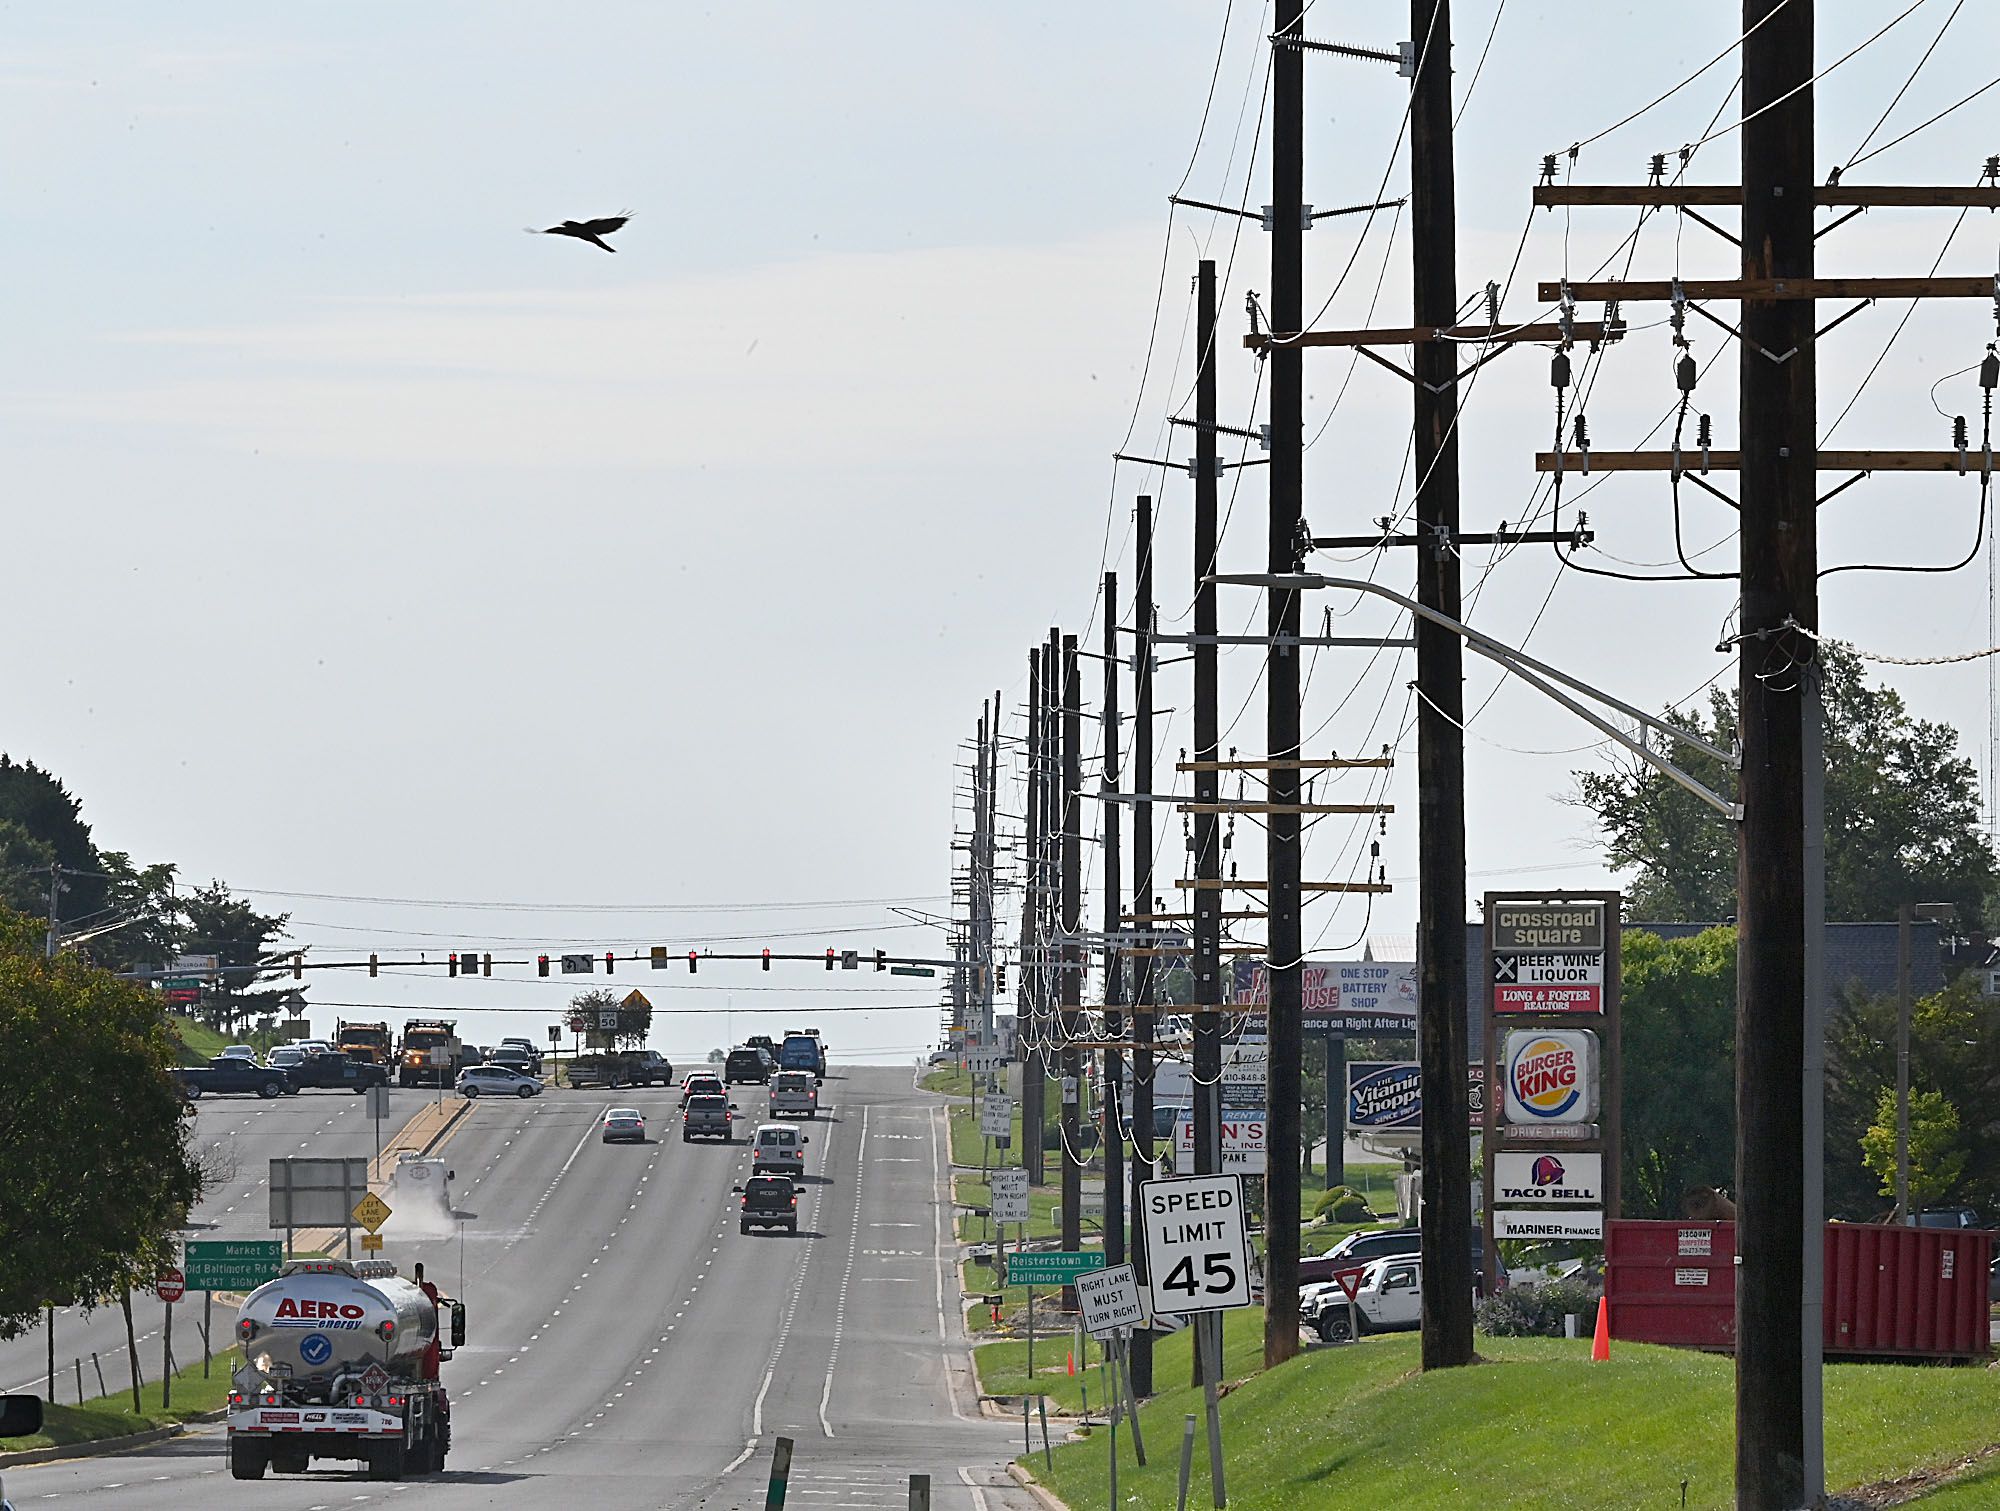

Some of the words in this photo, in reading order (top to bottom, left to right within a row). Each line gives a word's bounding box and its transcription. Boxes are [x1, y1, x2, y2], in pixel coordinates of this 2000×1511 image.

[1500, 909, 1595, 927] crossroad
[1514, 930, 1581, 946] square
[1340, 968, 1360, 978] ONE
[1363, 968, 1389, 978] STOP
[1532, 969, 1588, 982] LIQUOR
[1342, 983, 1387, 993] BATTERY
[1502, 990, 1532, 1000] LONG
[1536, 990, 1544, 1000] &
[1548, 990, 1590, 1000] FOSTER
[1352, 998, 1378, 1008] SHOP
[1524, 1002, 1570, 1010] REALTORS
[602, 1018, 616, 1027] 50
[1331, 1020, 1343, 1028] on
[1346, 1018, 1372, 1030] Right
[1374, 1018, 1399, 1028] After
[1517, 1050, 1574, 1080] BURGER
[1376, 1077, 1392, 1086] THE
[1520, 1065, 1576, 1100] KING
[1226, 1112, 1256, 1120] RENT
[1374, 1112, 1398, 1124] SINCE
[1510, 1128, 1542, 1137] DRIVE
[1551, 1128, 1578, 1137] THRU
[1502, 1188, 1546, 1198] TACO
[1552, 1189, 1594, 1198] BELL
[1151, 1190, 1233, 1214] SPEED
[1162, 1221, 1226, 1244] LIMIT
[1506, 1224, 1562, 1235] MARINER
[226, 1246, 260, 1255] Market
[268, 1246, 280, 1255] St
[1012, 1256, 1081, 1266] Reisterstown
[1090, 1256, 1102, 1265] 12
[186, 1264, 202, 1274] Old
[204, 1264, 250, 1274] Baltimore
[255, 1264, 267, 1273] Rd
[1162, 1252, 1236, 1296] 45
[200, 1278, 223, 1286] NEXT
[1012, 1272, 1063, 1282] Baltimore
[1081, 1279, 1104, 1292] RIGHT
[1109, 1272, 1130, 1285] LANE
[1094, 1290, 1124, 1307] MUST
[276, 1298, 364, 1319] AERO
[1088, 1312, 1110, 1324] TURN
[1113, 1305, 1136, 1318] RIGHT
[318, 1320, 362, 1330] energy
